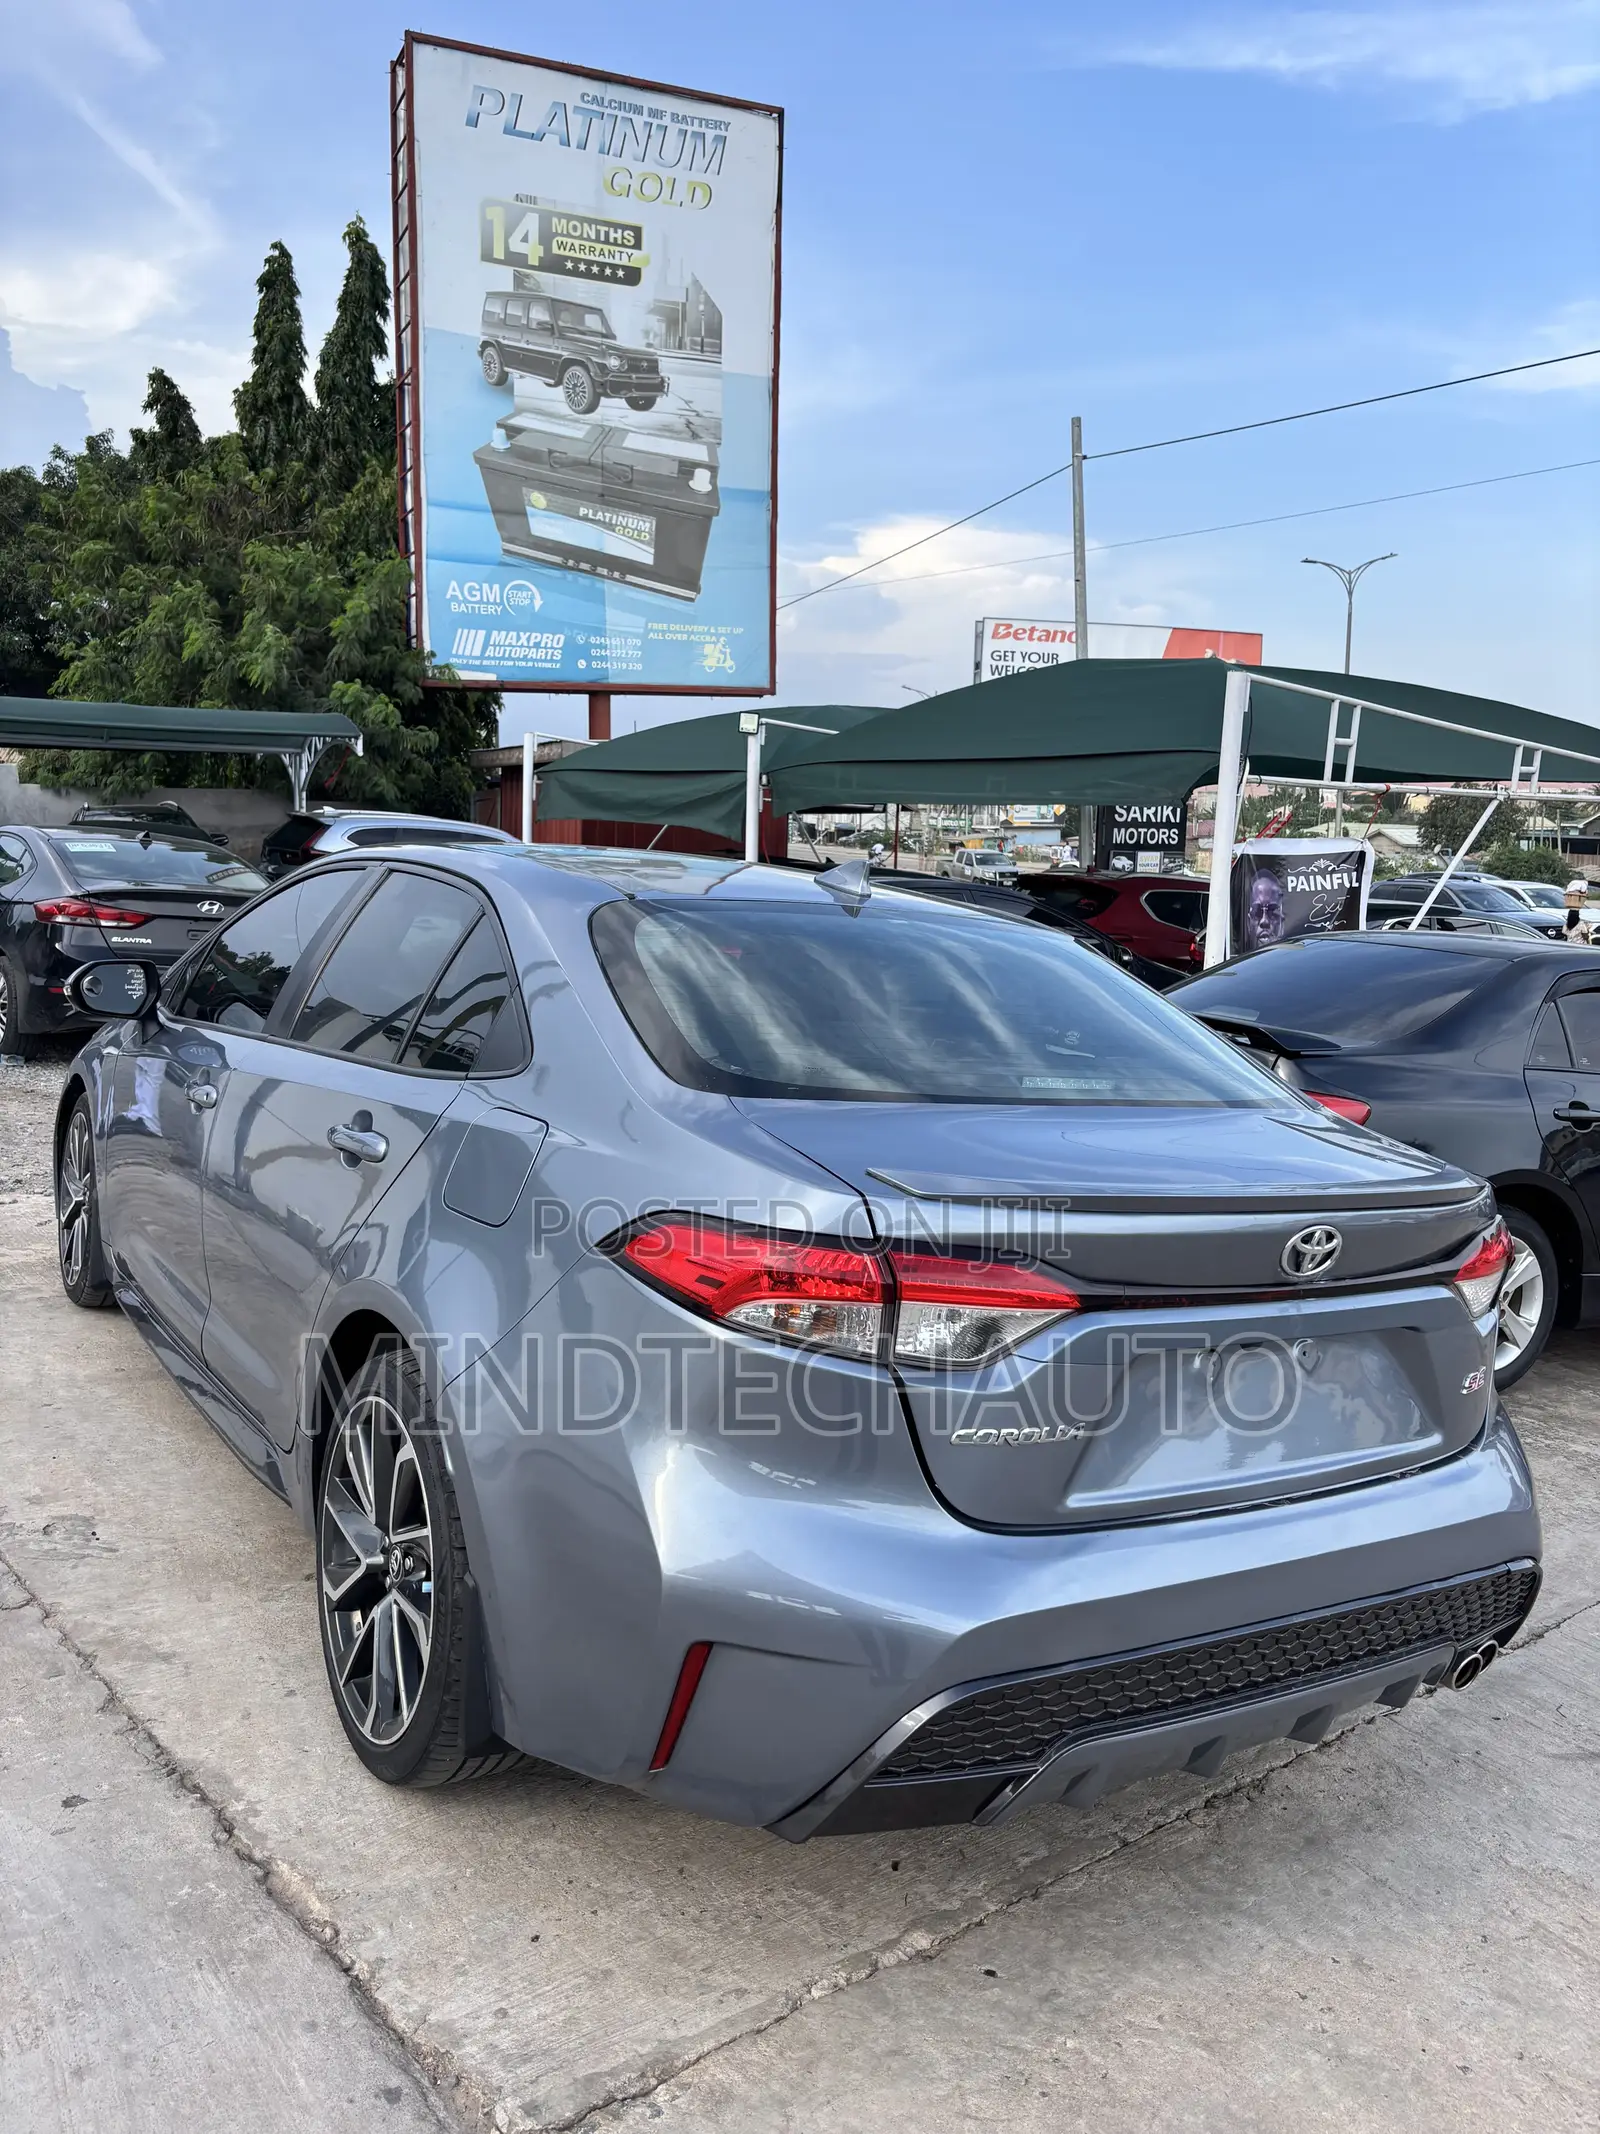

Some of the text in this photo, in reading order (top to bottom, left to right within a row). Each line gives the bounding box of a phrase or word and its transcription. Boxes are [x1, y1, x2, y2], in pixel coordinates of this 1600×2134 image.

[580, 92, 731, 132] CALCIUM MF BATTERY
[465, 84, 727, 175] PLATINUM
[603, 166, 712, 210] GOLD
[485, 206, 544, 266] 14
[552, 216, 635, 246] MONTHS
[556, 239, 634, 263] WARRANTY
[579, 507, 651, 532] PLATINUM
[615, 526, 650, 541] GOLD
[446, 580, 500, 603] AGM
[508, 590, 532, 599] START
[450, 602, 503, 615] BATTERY
[509, 598, 531, 606] STOP
[648, 623, 669, 631] FREE
[669, 623, 709, 633] DELIVERY
[717, 626, 732, 634] SET
[648, 632, 717, 643] ALL OVER ACCRA
[489, 630, 565, 649] MAXPRO
[485, 646, 563, 661] AUTOPARTS
[990, 650, 1059, 665] GET YOUR
[533, 661, 560, 669] VEHICLE
[1114, 805, 1180, 823] SARIKI
[1112, 828, 1179, 845] MOTORS
[1287, 871, 1359, 893] PAINFUL
[111, 936, 152, 945] ELANTRA
[1460, 1366, 1486, 1395] SE
[950, 1422, 1086, 1447] COROLLA
